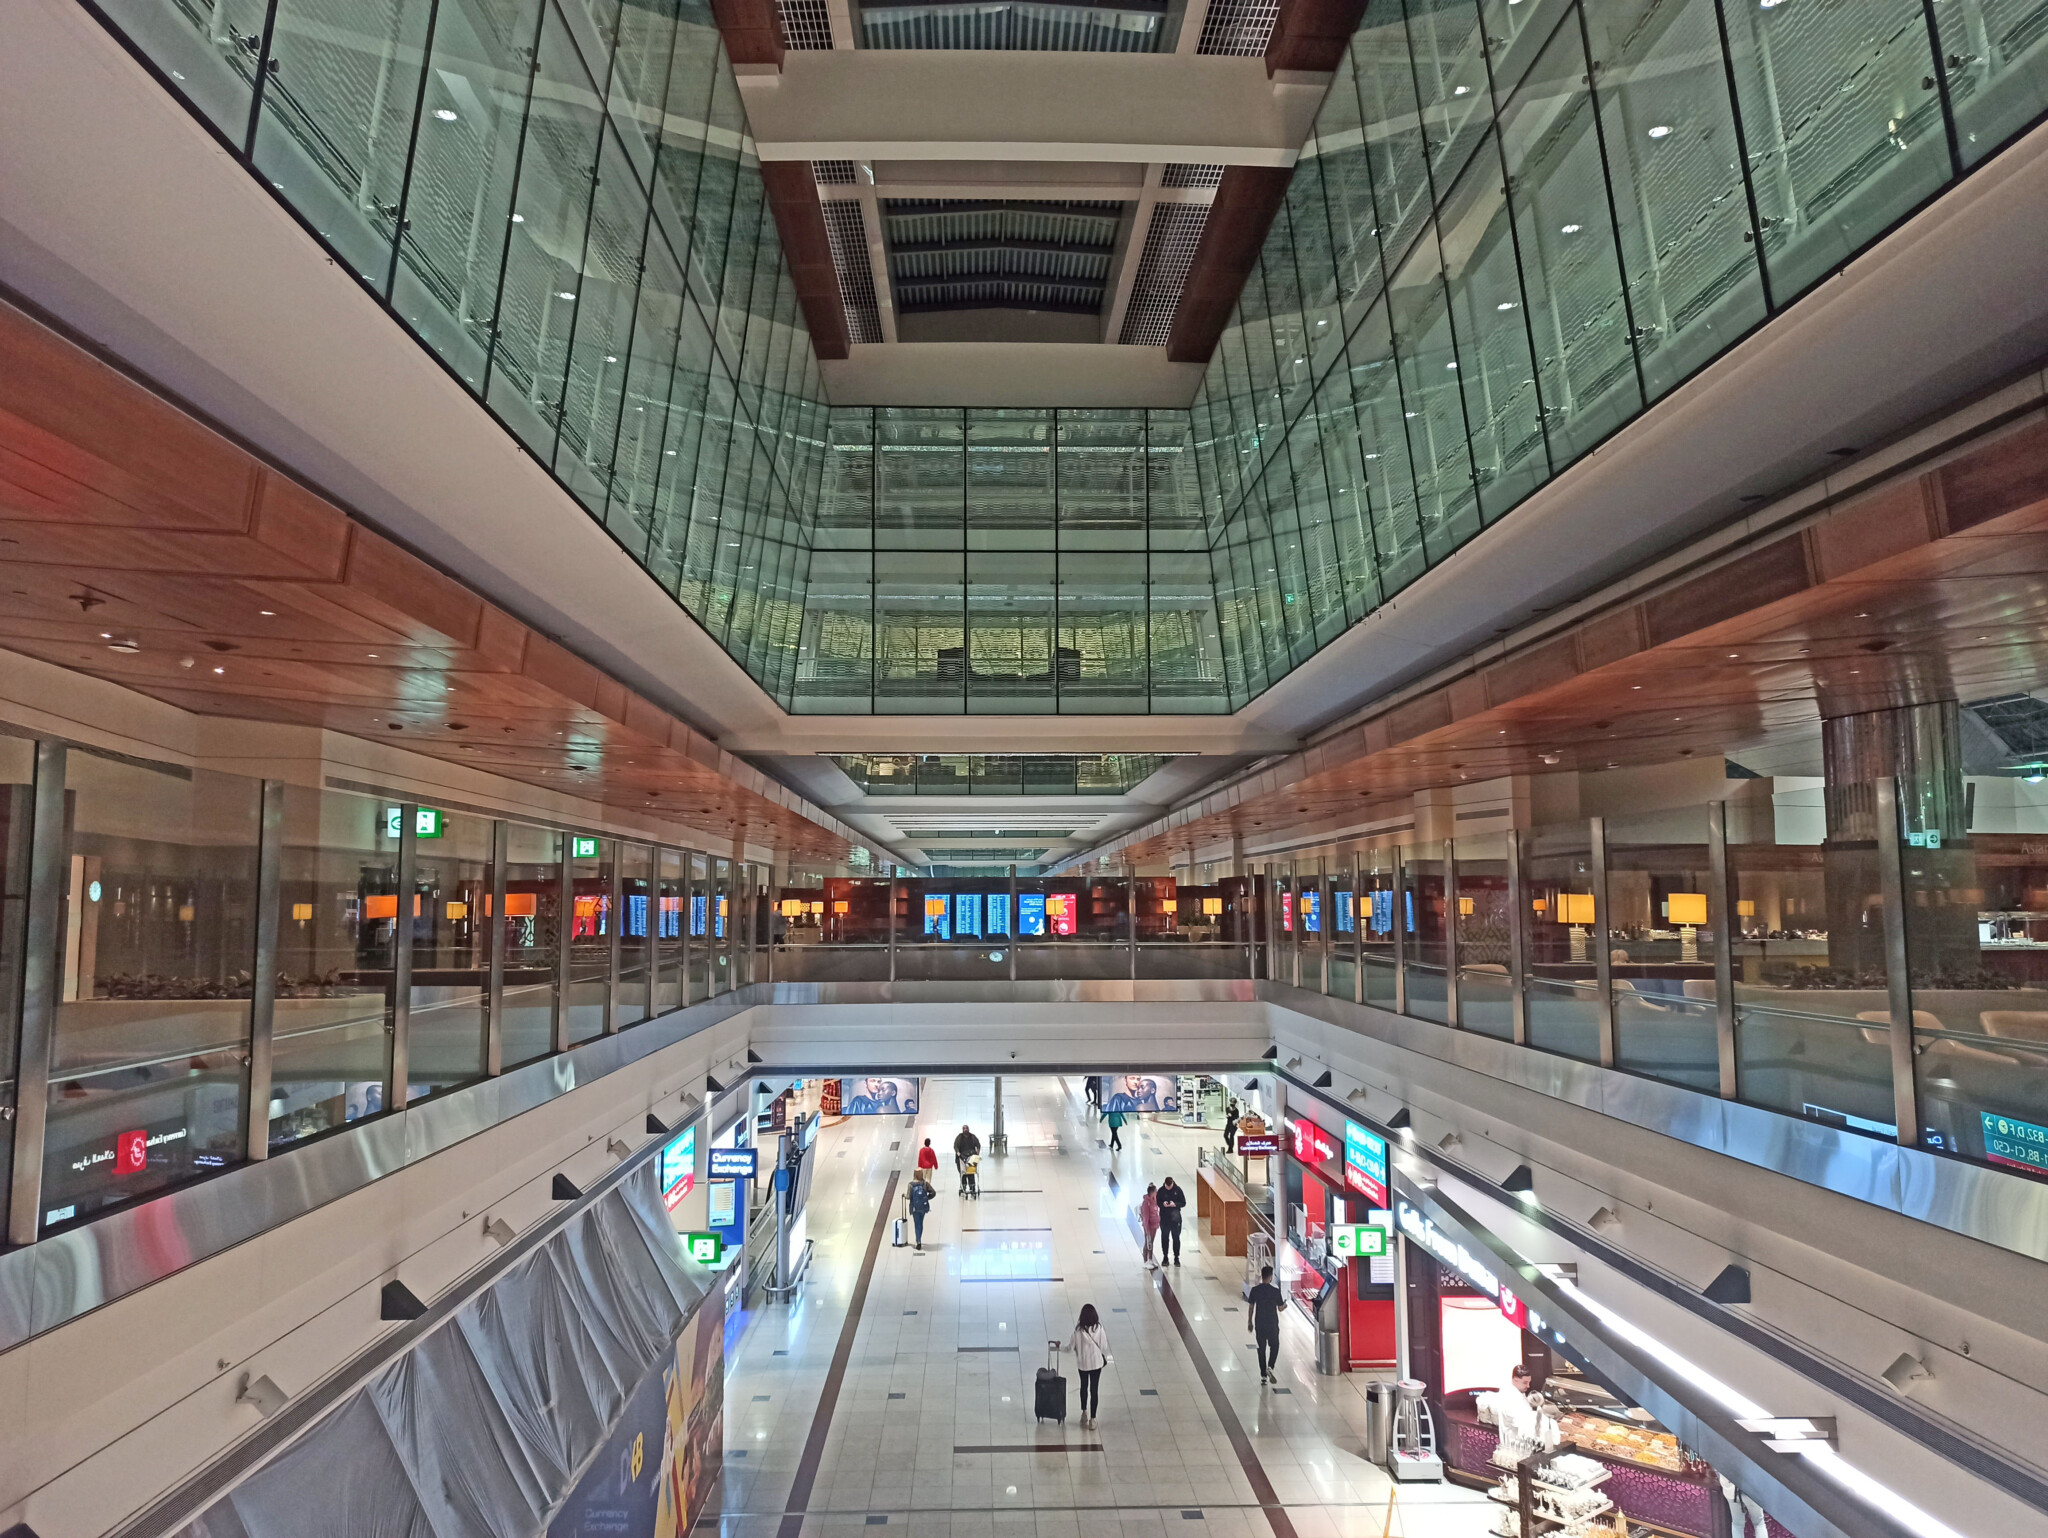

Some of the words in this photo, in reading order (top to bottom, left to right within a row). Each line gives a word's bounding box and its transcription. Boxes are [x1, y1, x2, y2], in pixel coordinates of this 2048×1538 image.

[712, 1153, 752, 1164] Currency
[711, 1164, 753, 1175] Exchange
[585, 1508, 629, 1520] Currency
[584, 1521, 629, 1533] Exchange
